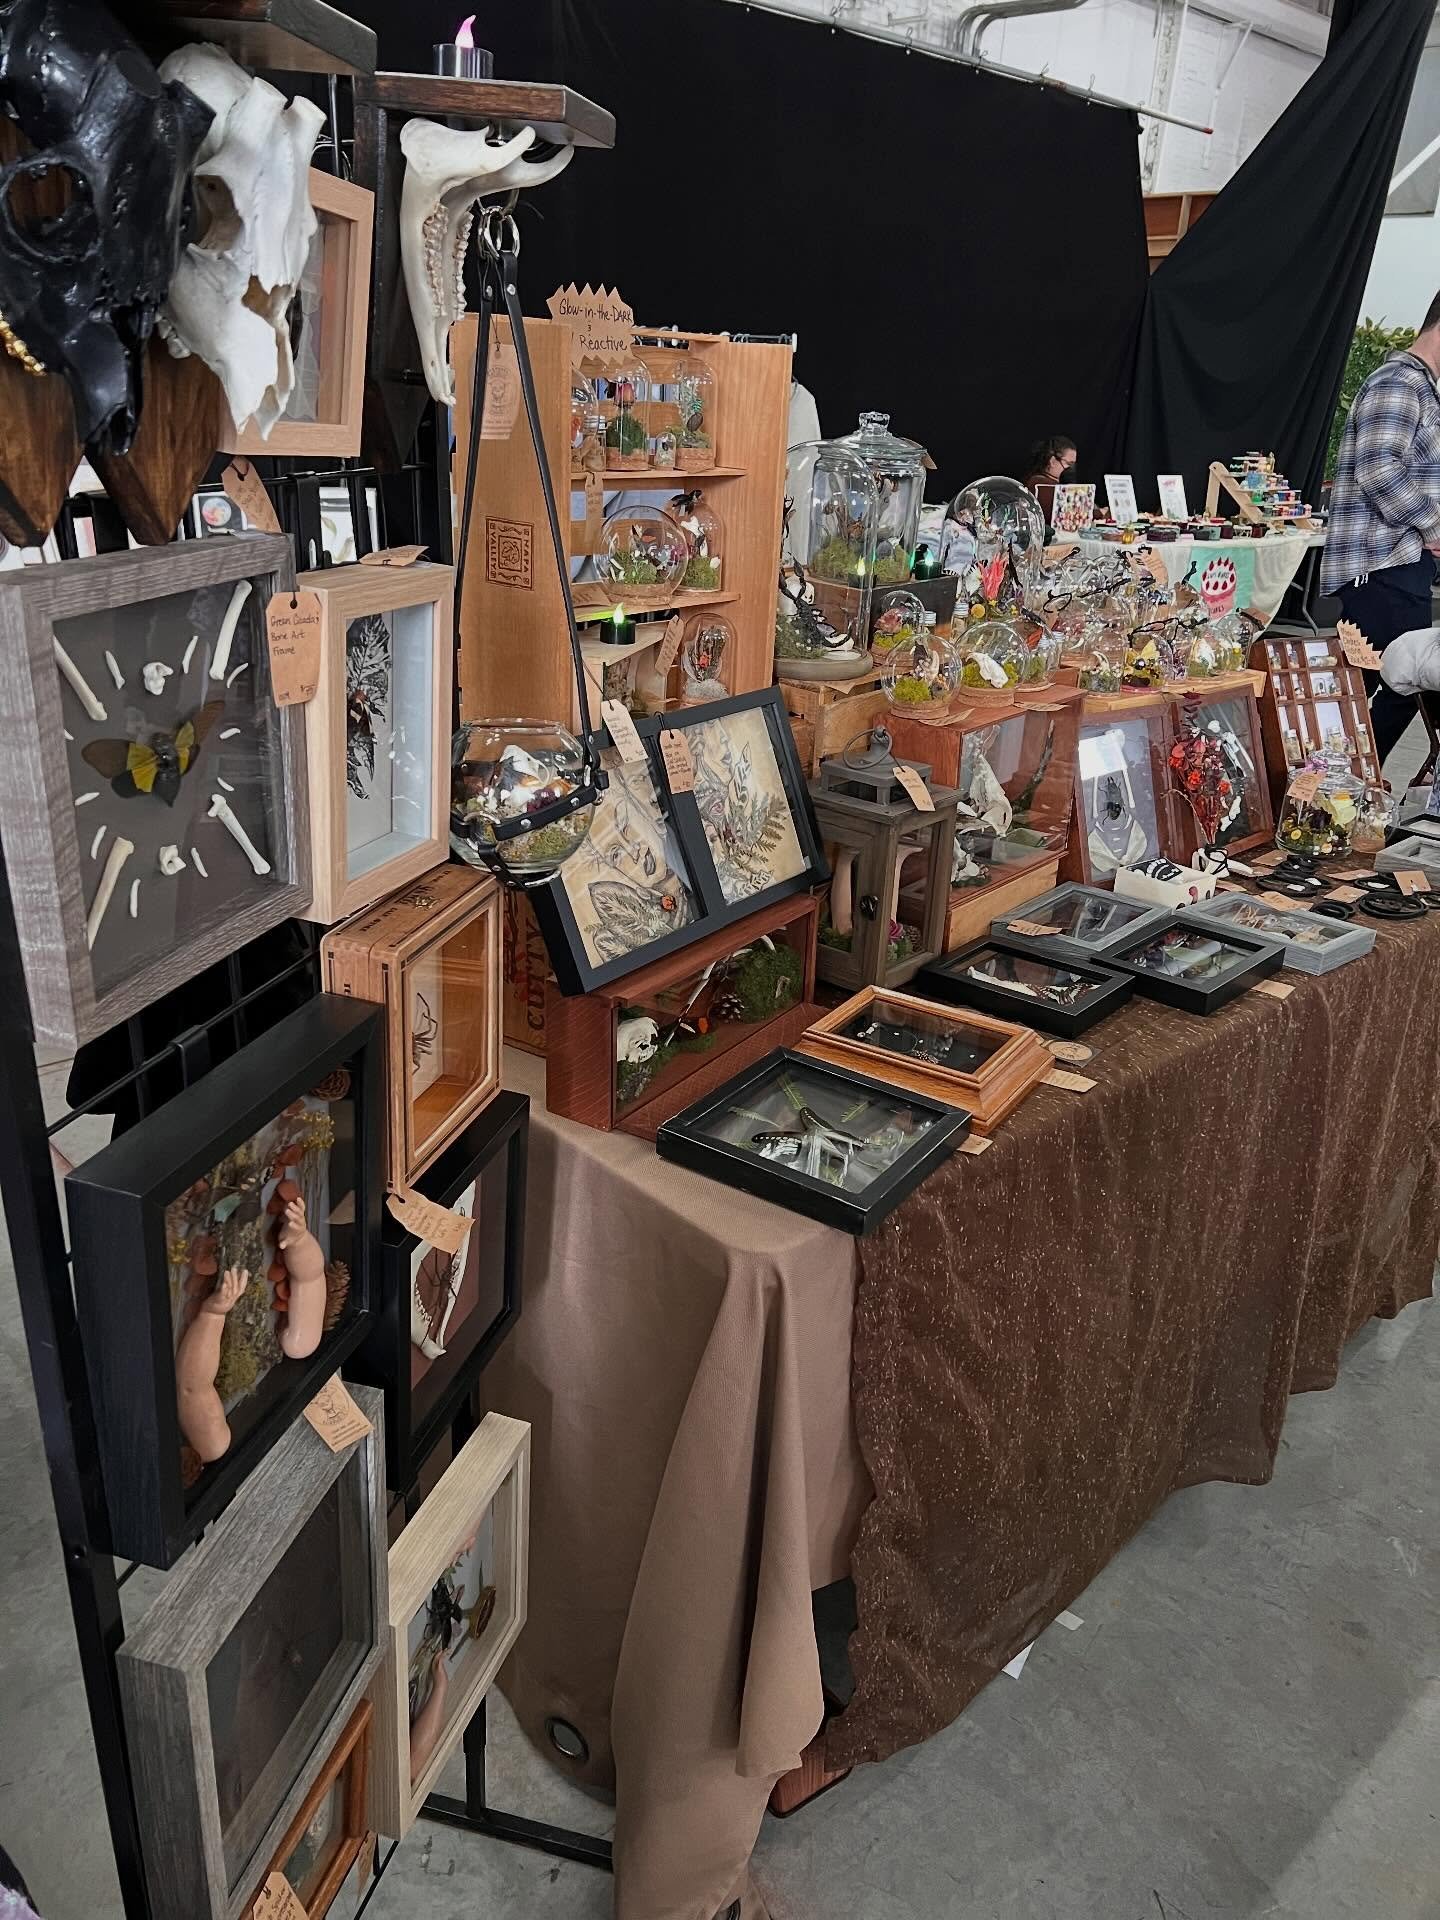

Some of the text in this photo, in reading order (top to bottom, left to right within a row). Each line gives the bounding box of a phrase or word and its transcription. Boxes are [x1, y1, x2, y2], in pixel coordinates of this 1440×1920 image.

[579, 335, 627, 351] Reactive
[489, 531, 497, 570] VALLEY
[292, 630, 305, 640] Art
[273, 646, 296, 656] Frame
